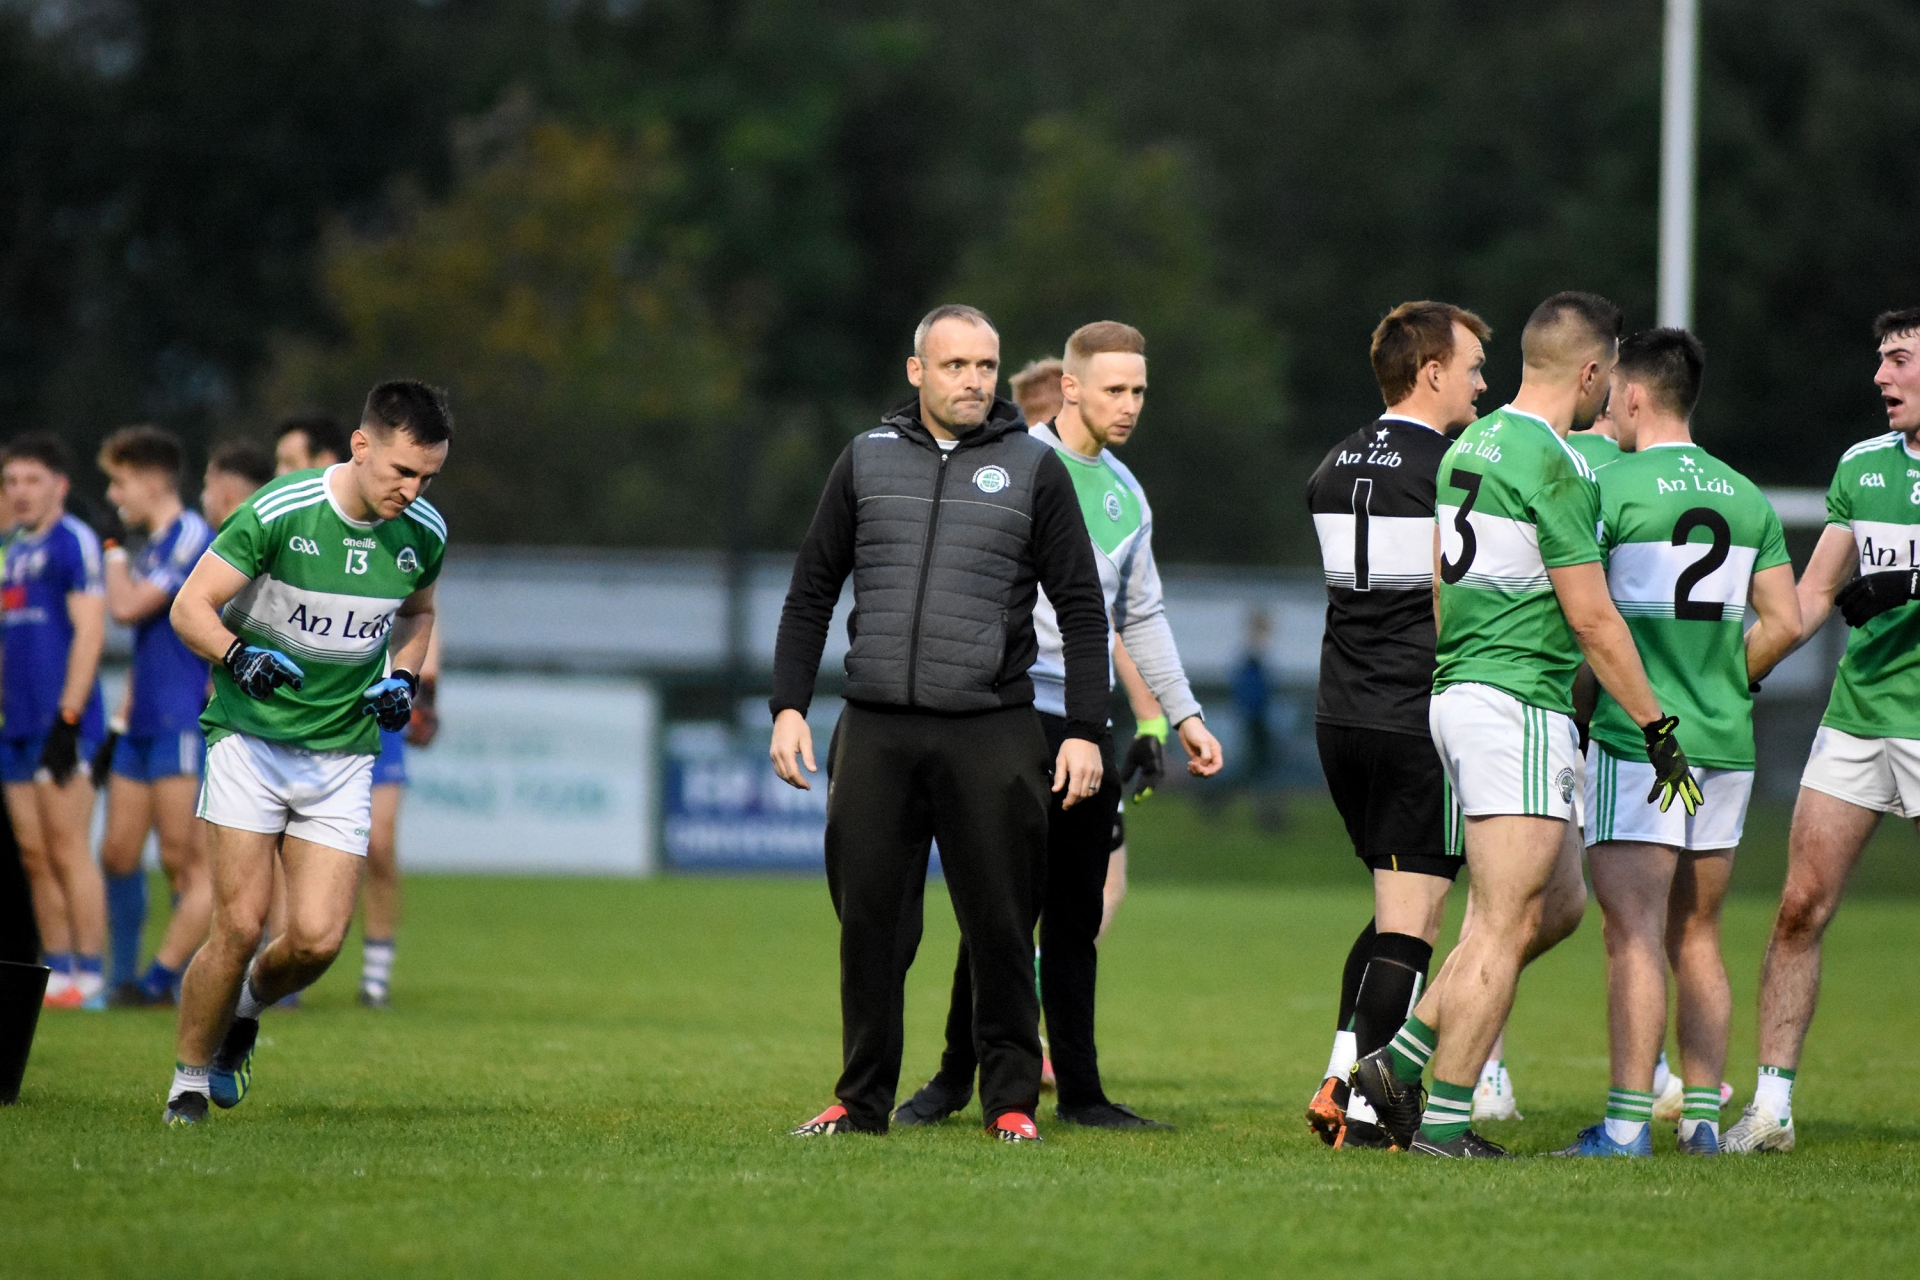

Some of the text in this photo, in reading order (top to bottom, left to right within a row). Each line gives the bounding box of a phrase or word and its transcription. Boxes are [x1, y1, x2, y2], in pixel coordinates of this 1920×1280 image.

[1335, 450, 1402, 468] An Lúb
[1455, 439, 1502, 463] An Lúb
[1656, 475, 1734, 496] An Lúb
[1352, 478, 1372, 592] 1
[1440, 468, 1484, 585] 3
[342, 537, 376, 549] oneills
[1861, 536, 1897, 567] An
[345, 549, 368, 575] 13
[1671, 507, 1731, 621] 2
[288, 604, 332, 636] An
